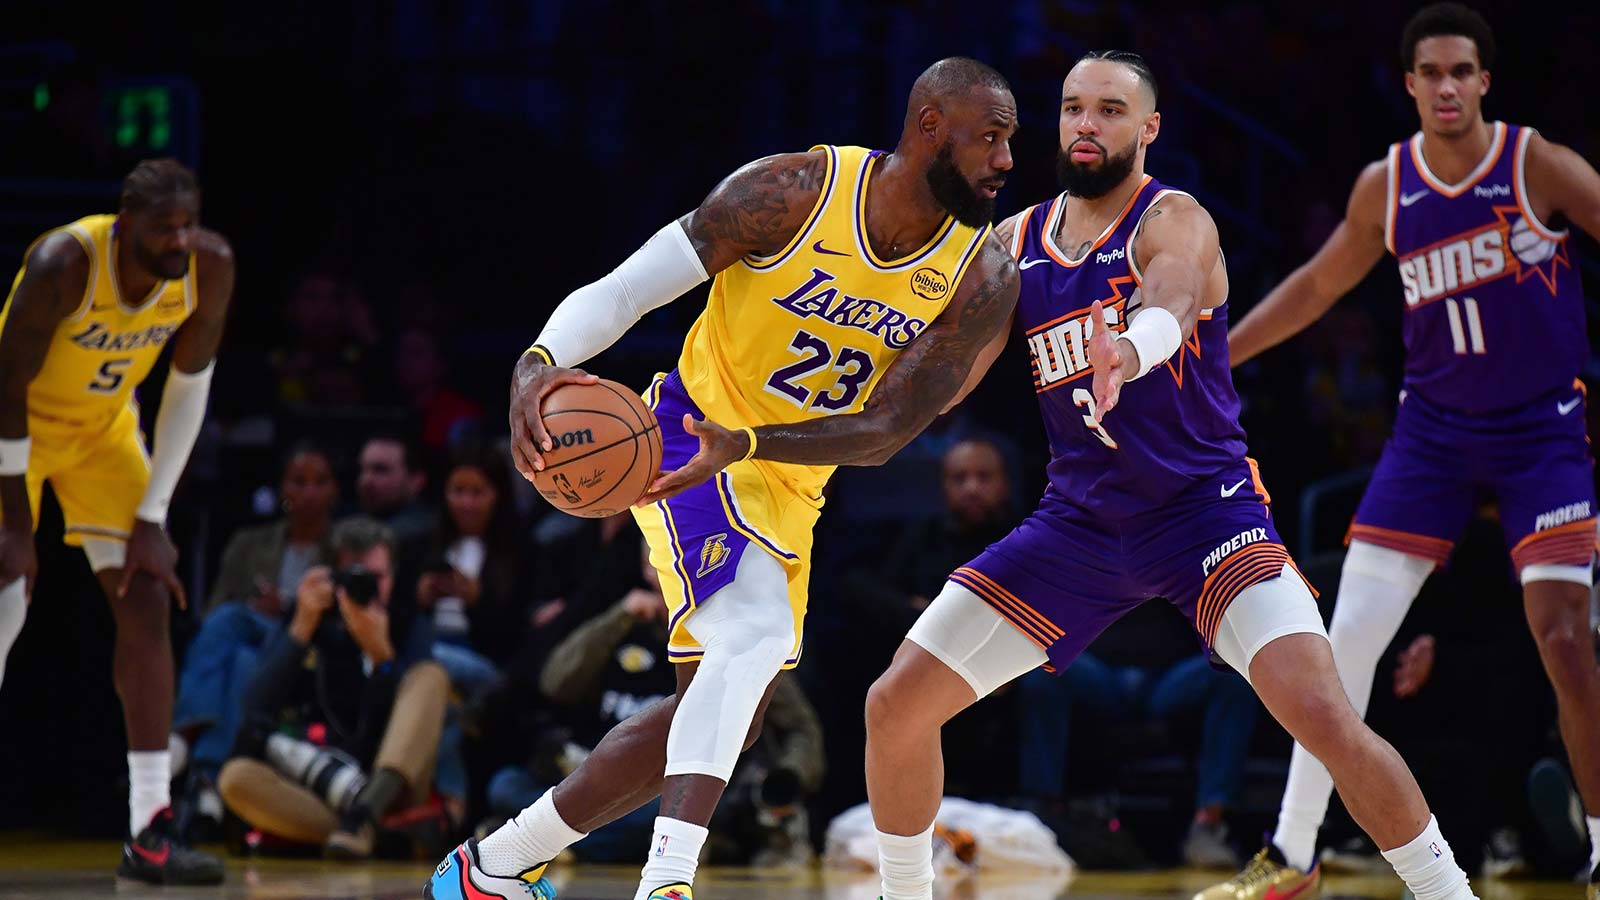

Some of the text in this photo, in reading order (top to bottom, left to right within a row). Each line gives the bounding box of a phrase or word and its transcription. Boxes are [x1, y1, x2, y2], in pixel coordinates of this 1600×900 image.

[1474, 184, 1511, 199] PayPal
[1096, 246, 1125, 265] PayPal
[1399, 229, 1506, 307] SUNS
[915, 272, 946, 293] bibigo
[770, 268, 926, 350] LAKERS
[1446, 297, 1487, 355] 11
[86, 358, 134, 395] 5
[763, 329, 876, 415] 23
[1535, 500, 1591, 534] PHOENIX
[1202, 527, 1269, 577] PHOENIX
